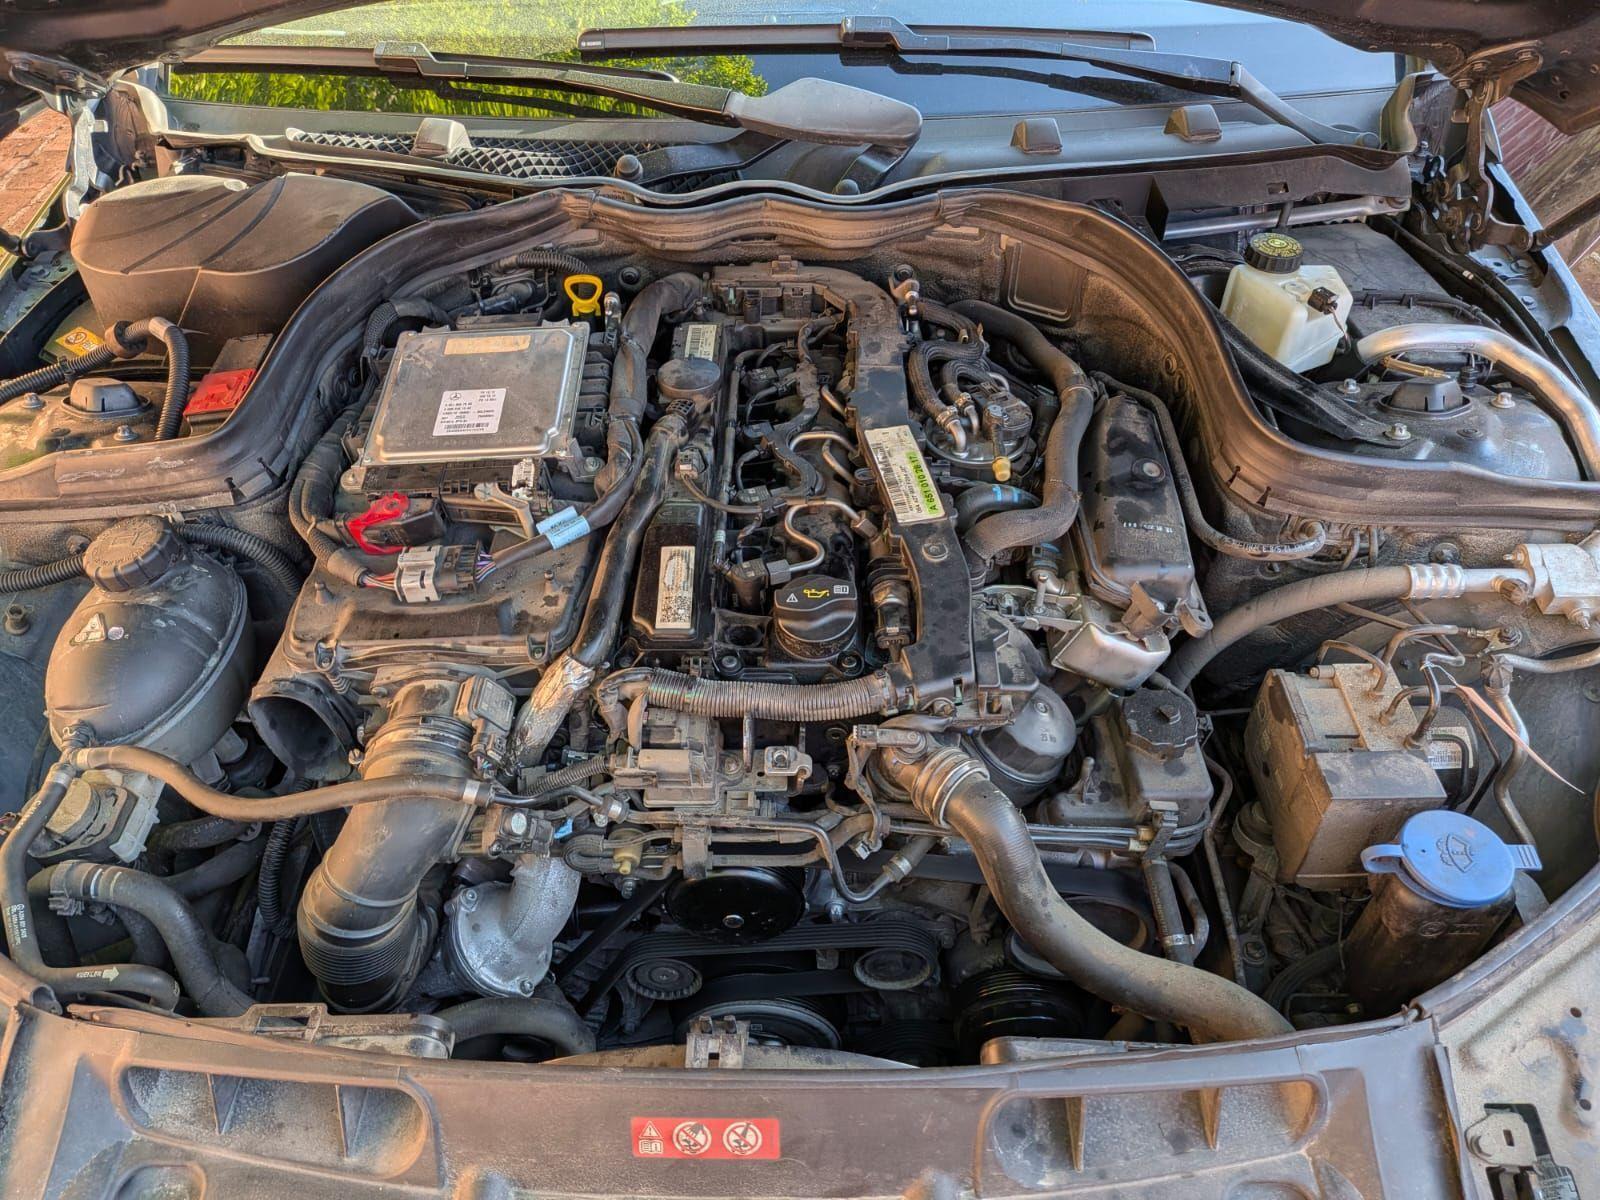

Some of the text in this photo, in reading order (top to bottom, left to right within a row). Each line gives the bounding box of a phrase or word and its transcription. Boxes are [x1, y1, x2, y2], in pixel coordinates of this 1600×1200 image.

[917, 474, 928, 487] 010
[923, 489, 934, 503] 651
[929, 504, 938, 512] A
